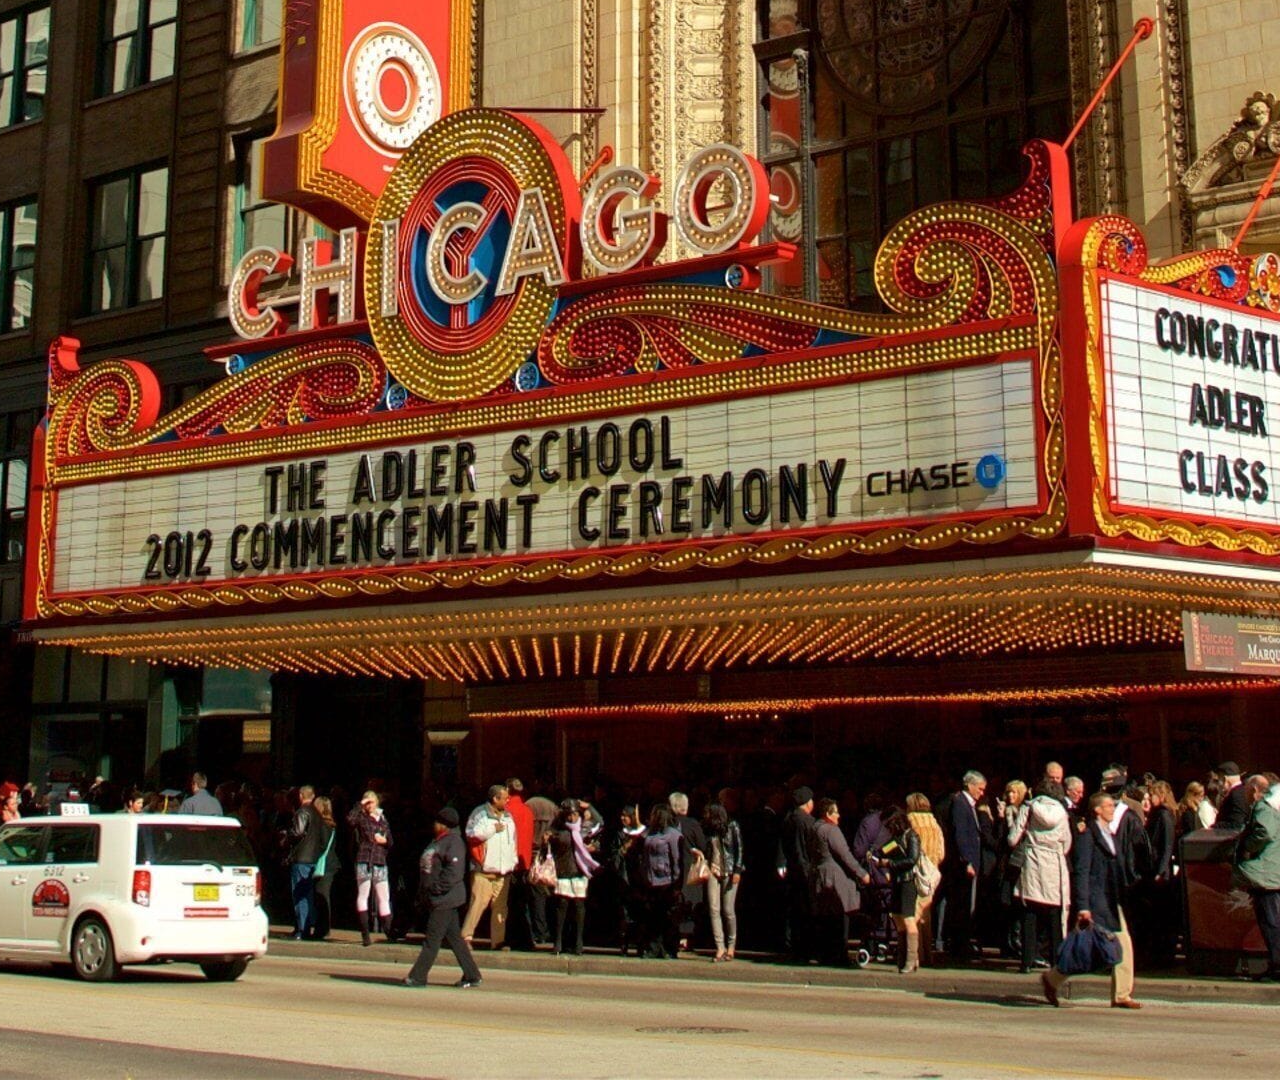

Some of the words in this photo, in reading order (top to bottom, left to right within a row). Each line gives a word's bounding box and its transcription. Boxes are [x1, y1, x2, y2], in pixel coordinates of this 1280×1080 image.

[228, 142, 764, 340] CHICAGO
[1189, 383, 1268, 437] ADLER
[265, 460, 327, 515] THE
[353, 441, 477, 505] ADLER
[509, 415, 684, 487] SCHOOL
[866, 461, 970, 498] CHASE
[1178, 449, 1269, 504] CLASS
[144, 528, 213, 580] 2012
[230, 493, 539, 572] COMMENCEMENT
[577, 457, 847, 541] CEREMONY
[1200, 633, 1234, 645] CHICAGO
[64, 805, 87, 815] 6312
[44, 865, 66, 876] 6312
[235, 884, 256, 897] 6312
